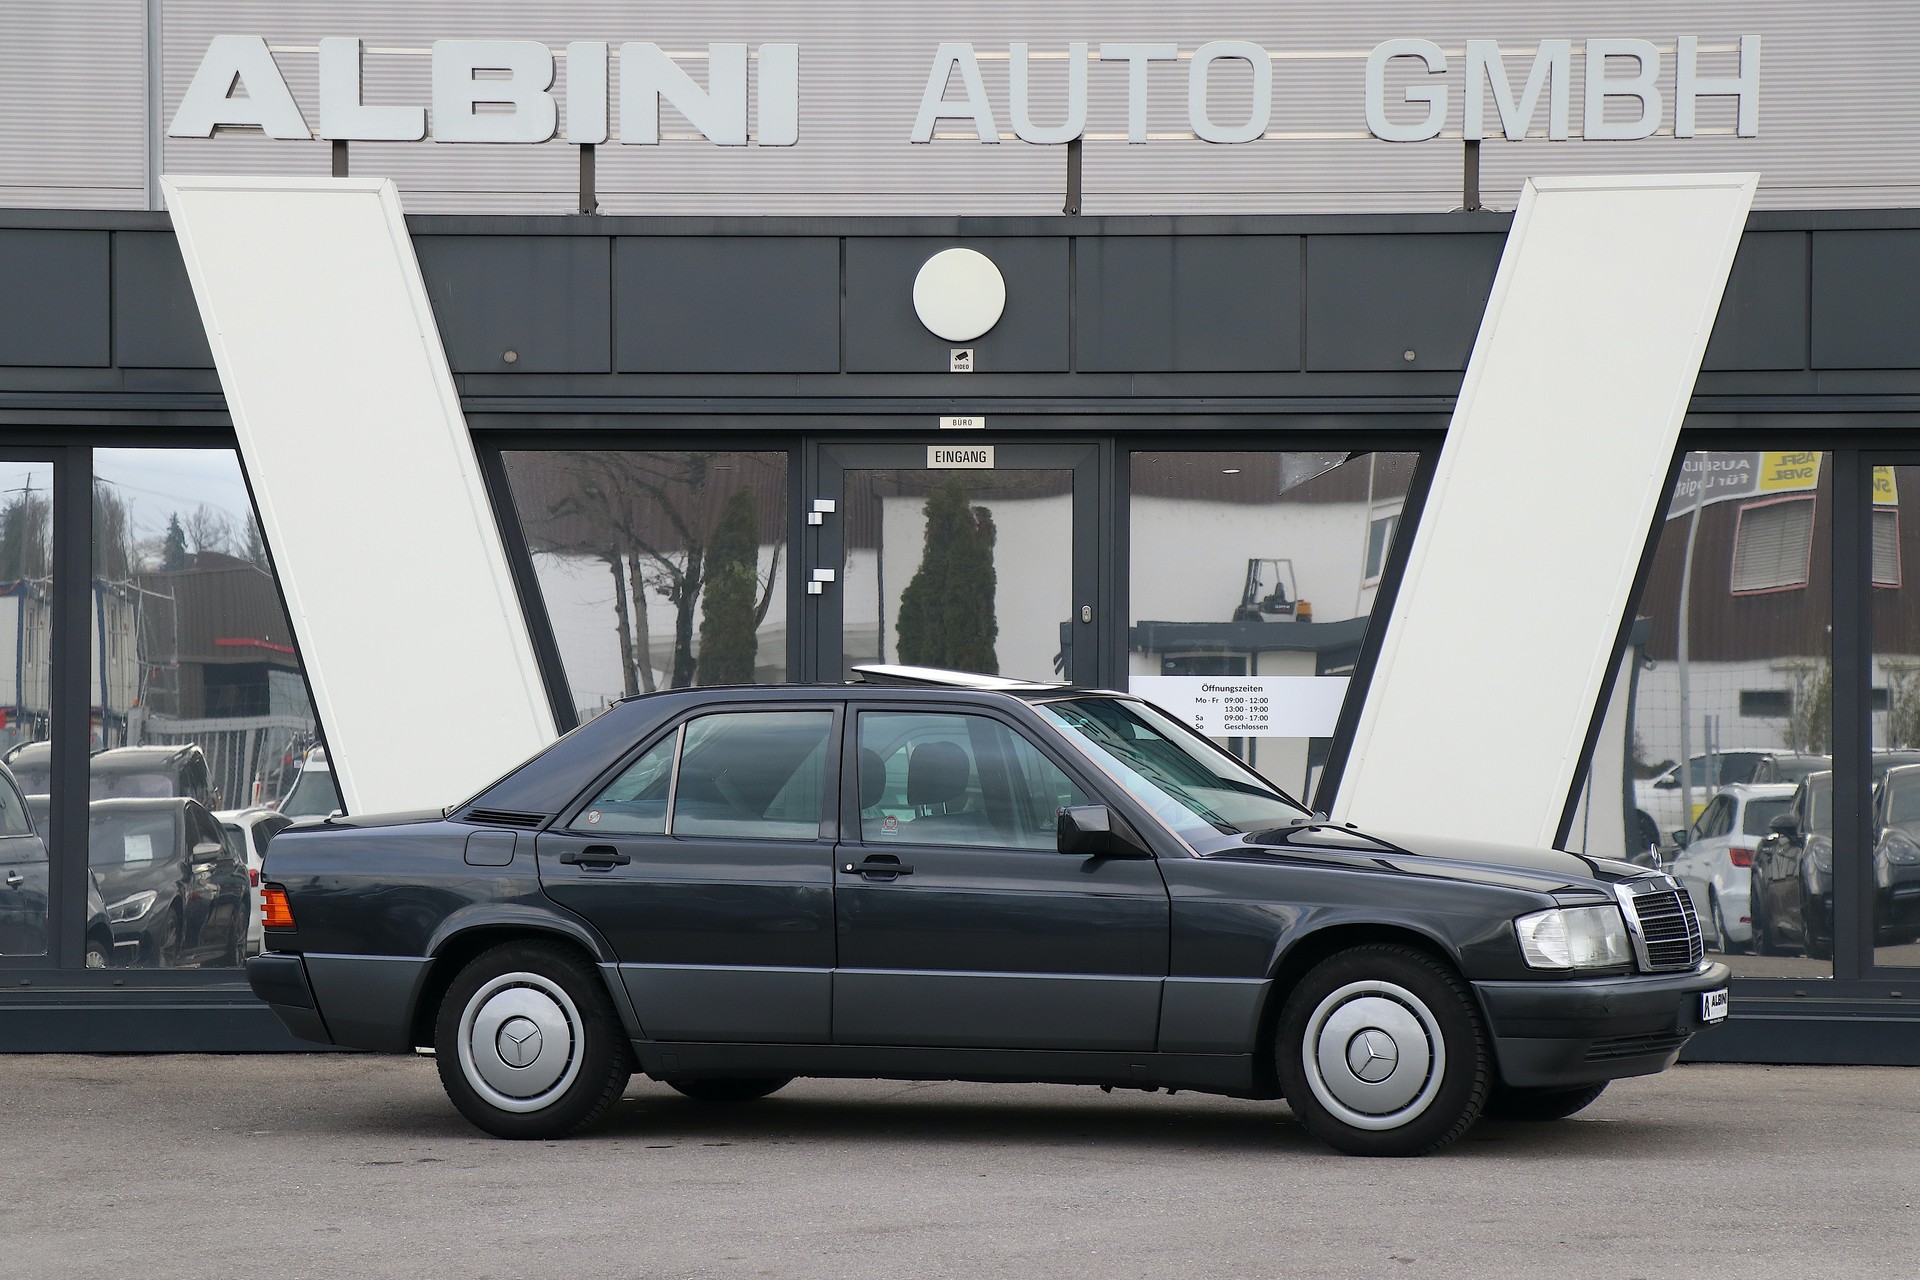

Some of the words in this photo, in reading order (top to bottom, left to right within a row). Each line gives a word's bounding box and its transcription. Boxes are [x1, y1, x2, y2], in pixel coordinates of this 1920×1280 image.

[167, 35, 800, 147] ALBINI
[909, 41, 1272, 146] AUTO
[1364, 35, 1762, 143] GMBH
[952, 417, 973, 426] BÜRO
[935, 450, 987, 463] EINGANG
[1201, 683, 1264, 693] Öffnungszeiten
